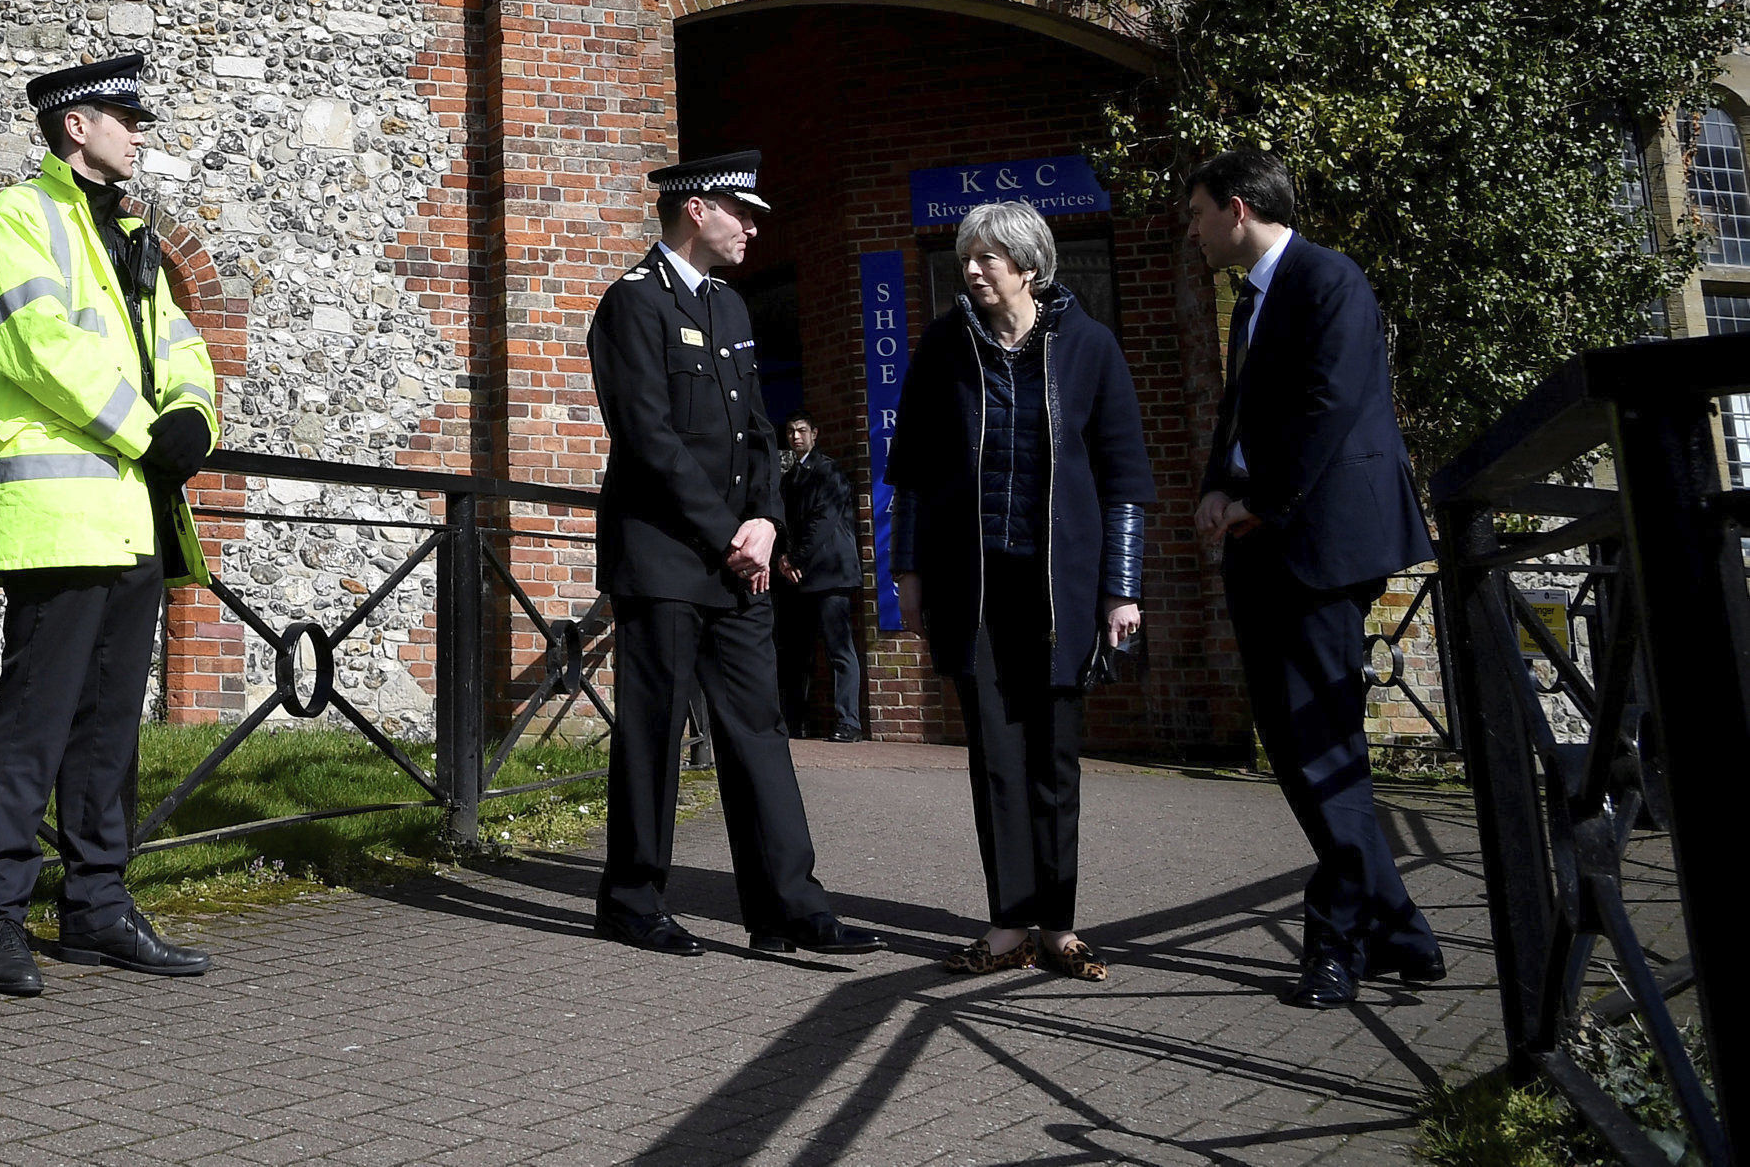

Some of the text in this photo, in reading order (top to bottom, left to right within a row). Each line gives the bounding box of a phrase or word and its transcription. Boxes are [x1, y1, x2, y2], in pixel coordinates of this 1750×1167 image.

[959, 164, 1057, 194] K & C
[874, 282, 898, 385] SHOE
